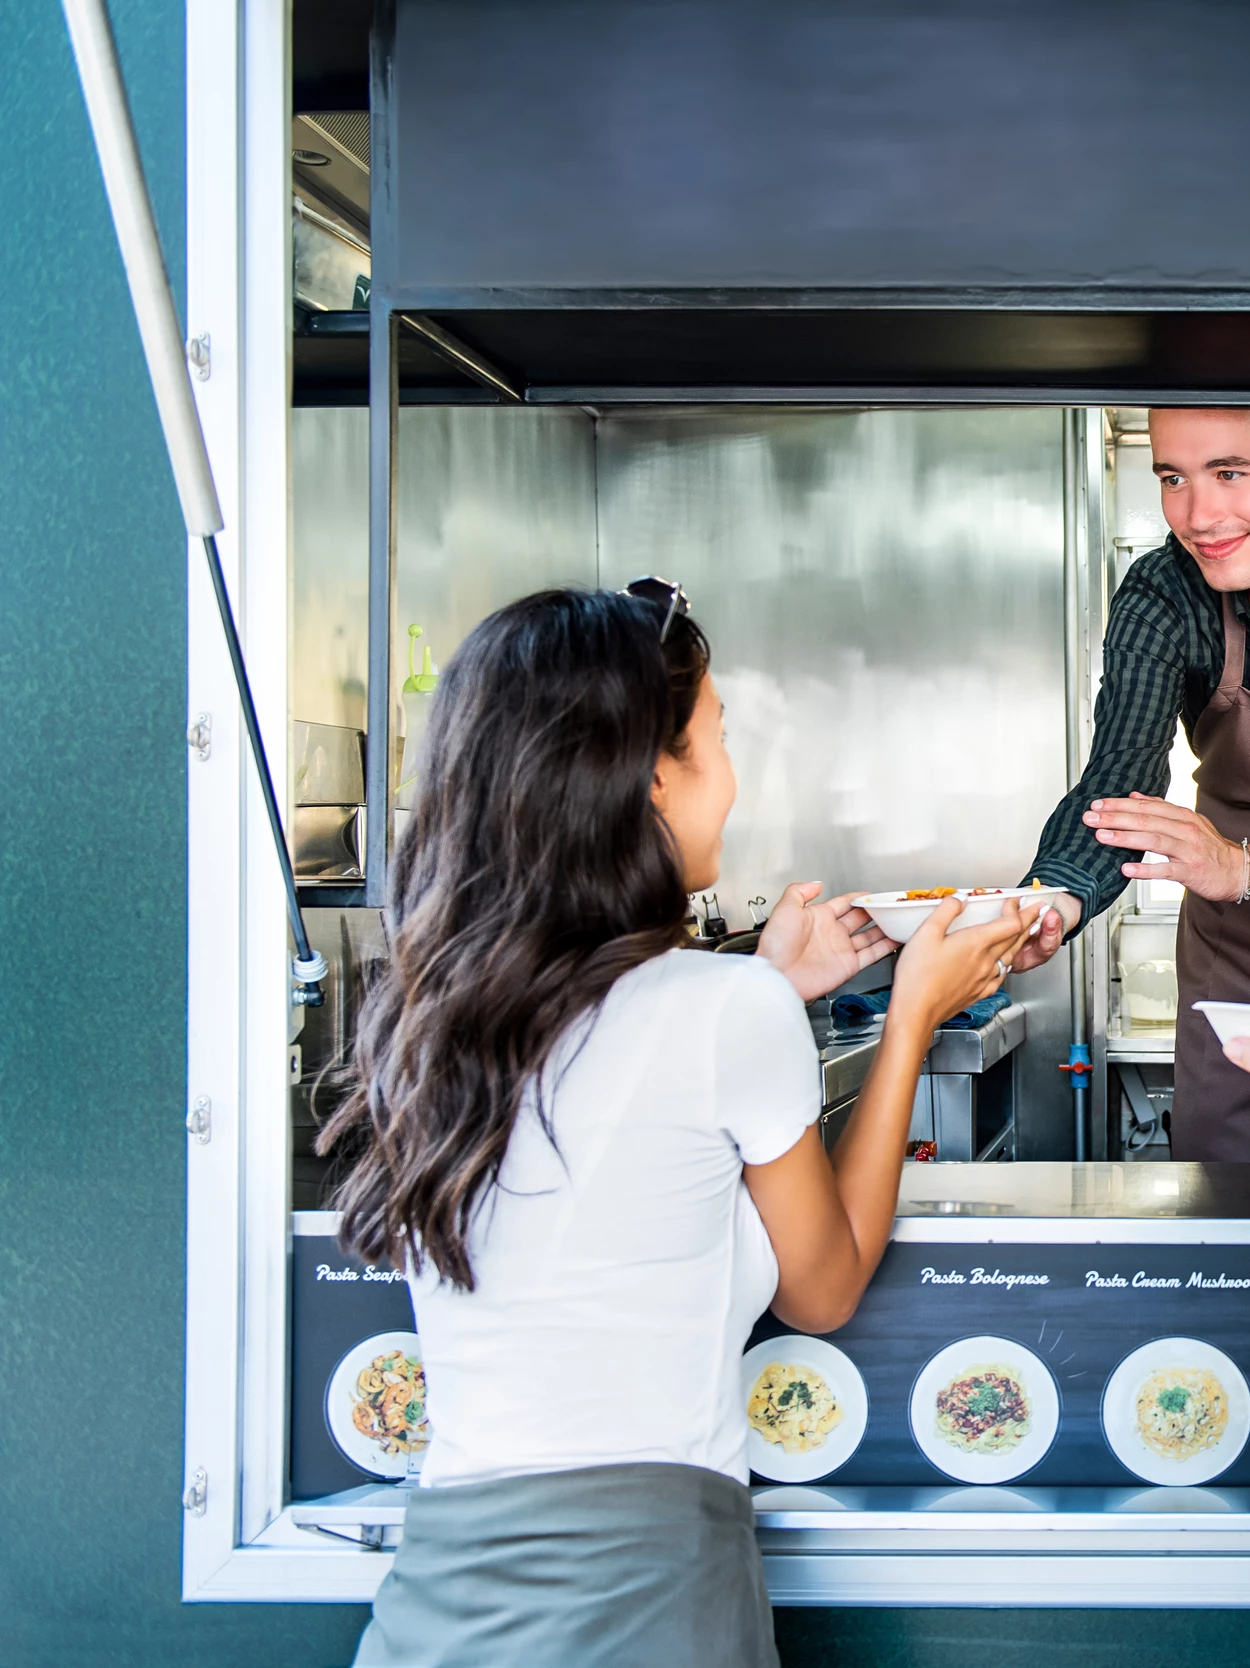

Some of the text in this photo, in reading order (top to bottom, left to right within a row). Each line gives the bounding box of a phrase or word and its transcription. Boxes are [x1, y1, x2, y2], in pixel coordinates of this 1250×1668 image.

[316, 1264, 360, 1281] Pasta
[921, 1267, 1050, 1290] Pasta Bolognese
[1085, 1270, 1129, 1288] Pasta
[1131, 1270, 1182, 1288] Cream
